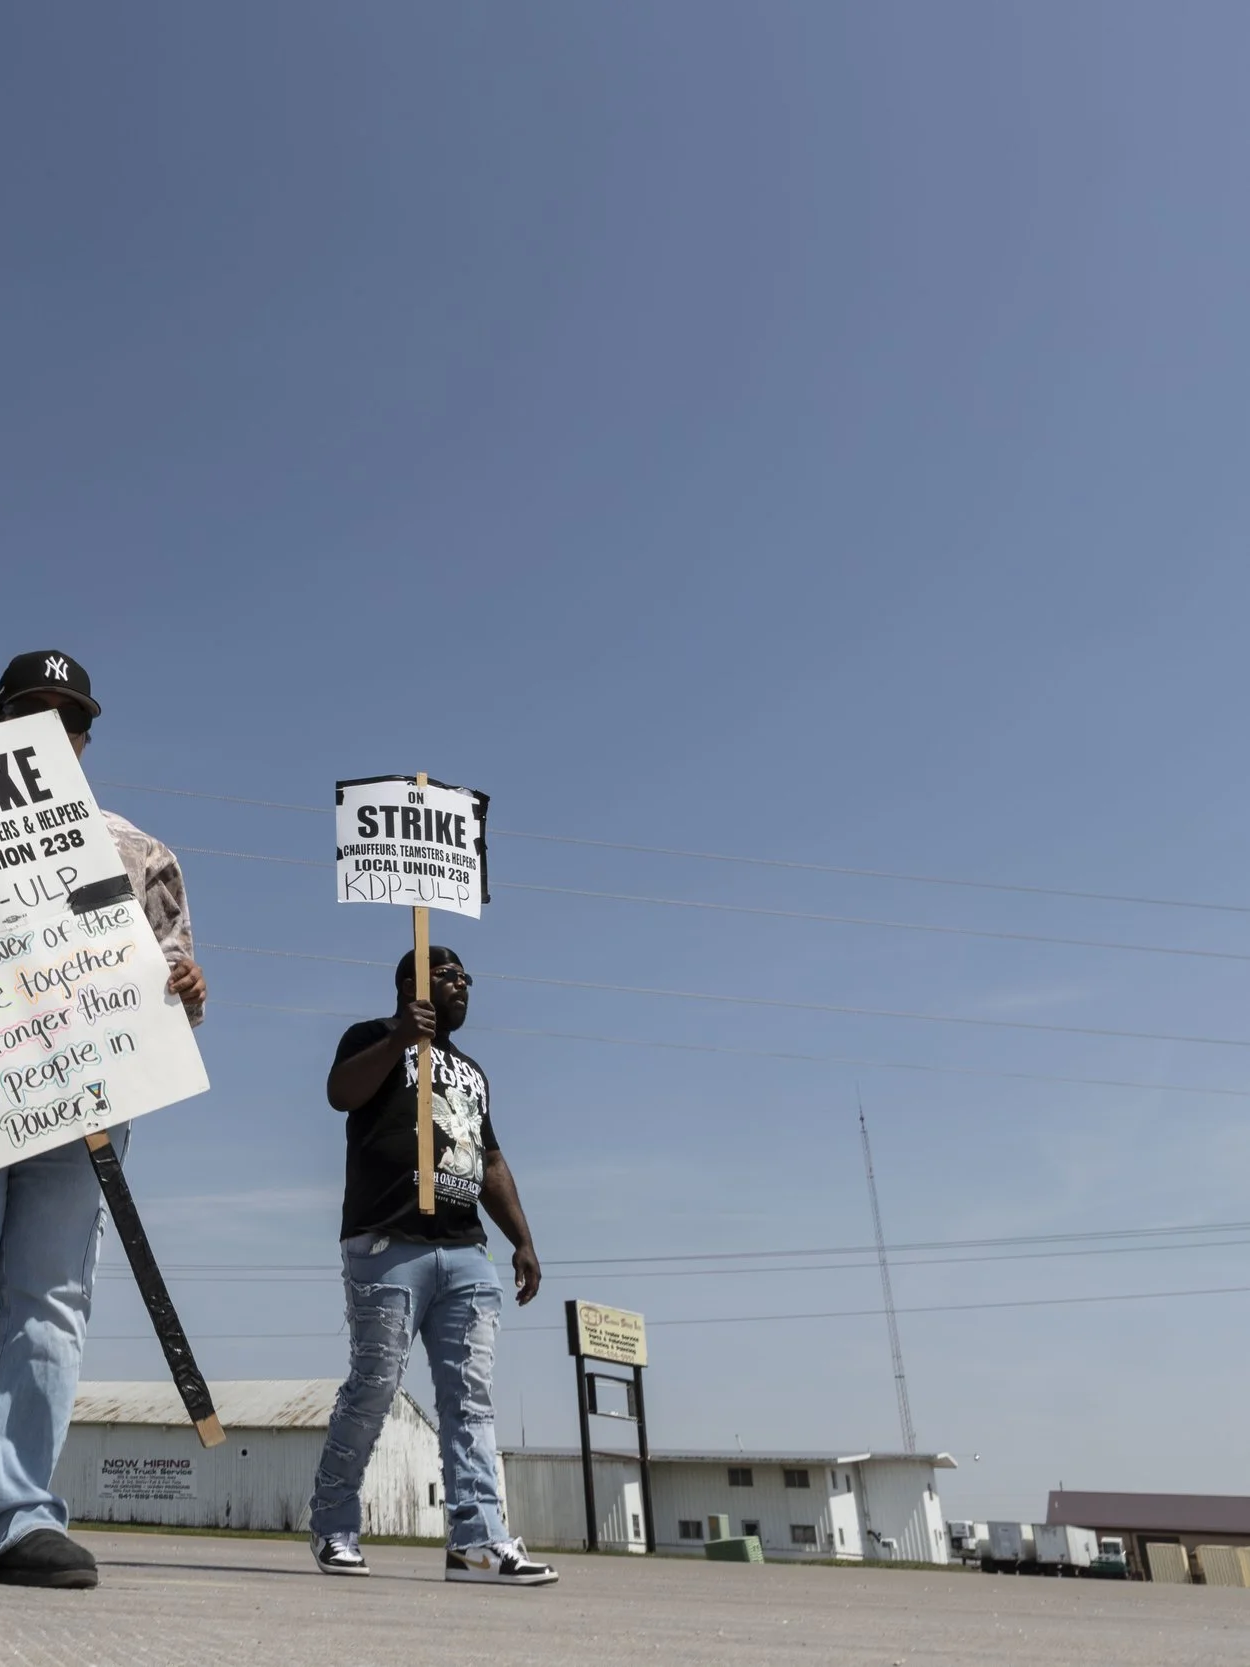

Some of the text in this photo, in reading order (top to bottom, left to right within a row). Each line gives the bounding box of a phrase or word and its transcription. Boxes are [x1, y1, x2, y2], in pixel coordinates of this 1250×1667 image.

[408, 791, 424, 805] ON
[23, 815, 36, 834] &
[36, 800, 90, 831] HELPERS
[357, 805, 467, 849] STRIKE
[40, 828, 85, 858] 238
[343, 844, 477, 871] CHAUFFEURS, TEAMSTERS & HELPERS
[355, 859, 469, 885] LOCAL UNION 238
[42, 919, 70, 949] of
[16, 943, 134, 999] together
[80, 985, 137, 1021] than
[109, 1031, 136, 1055] in
[439, 1173, 457, 1187] ONE
[104, 1459, 191, 1468] NOW HIRING
